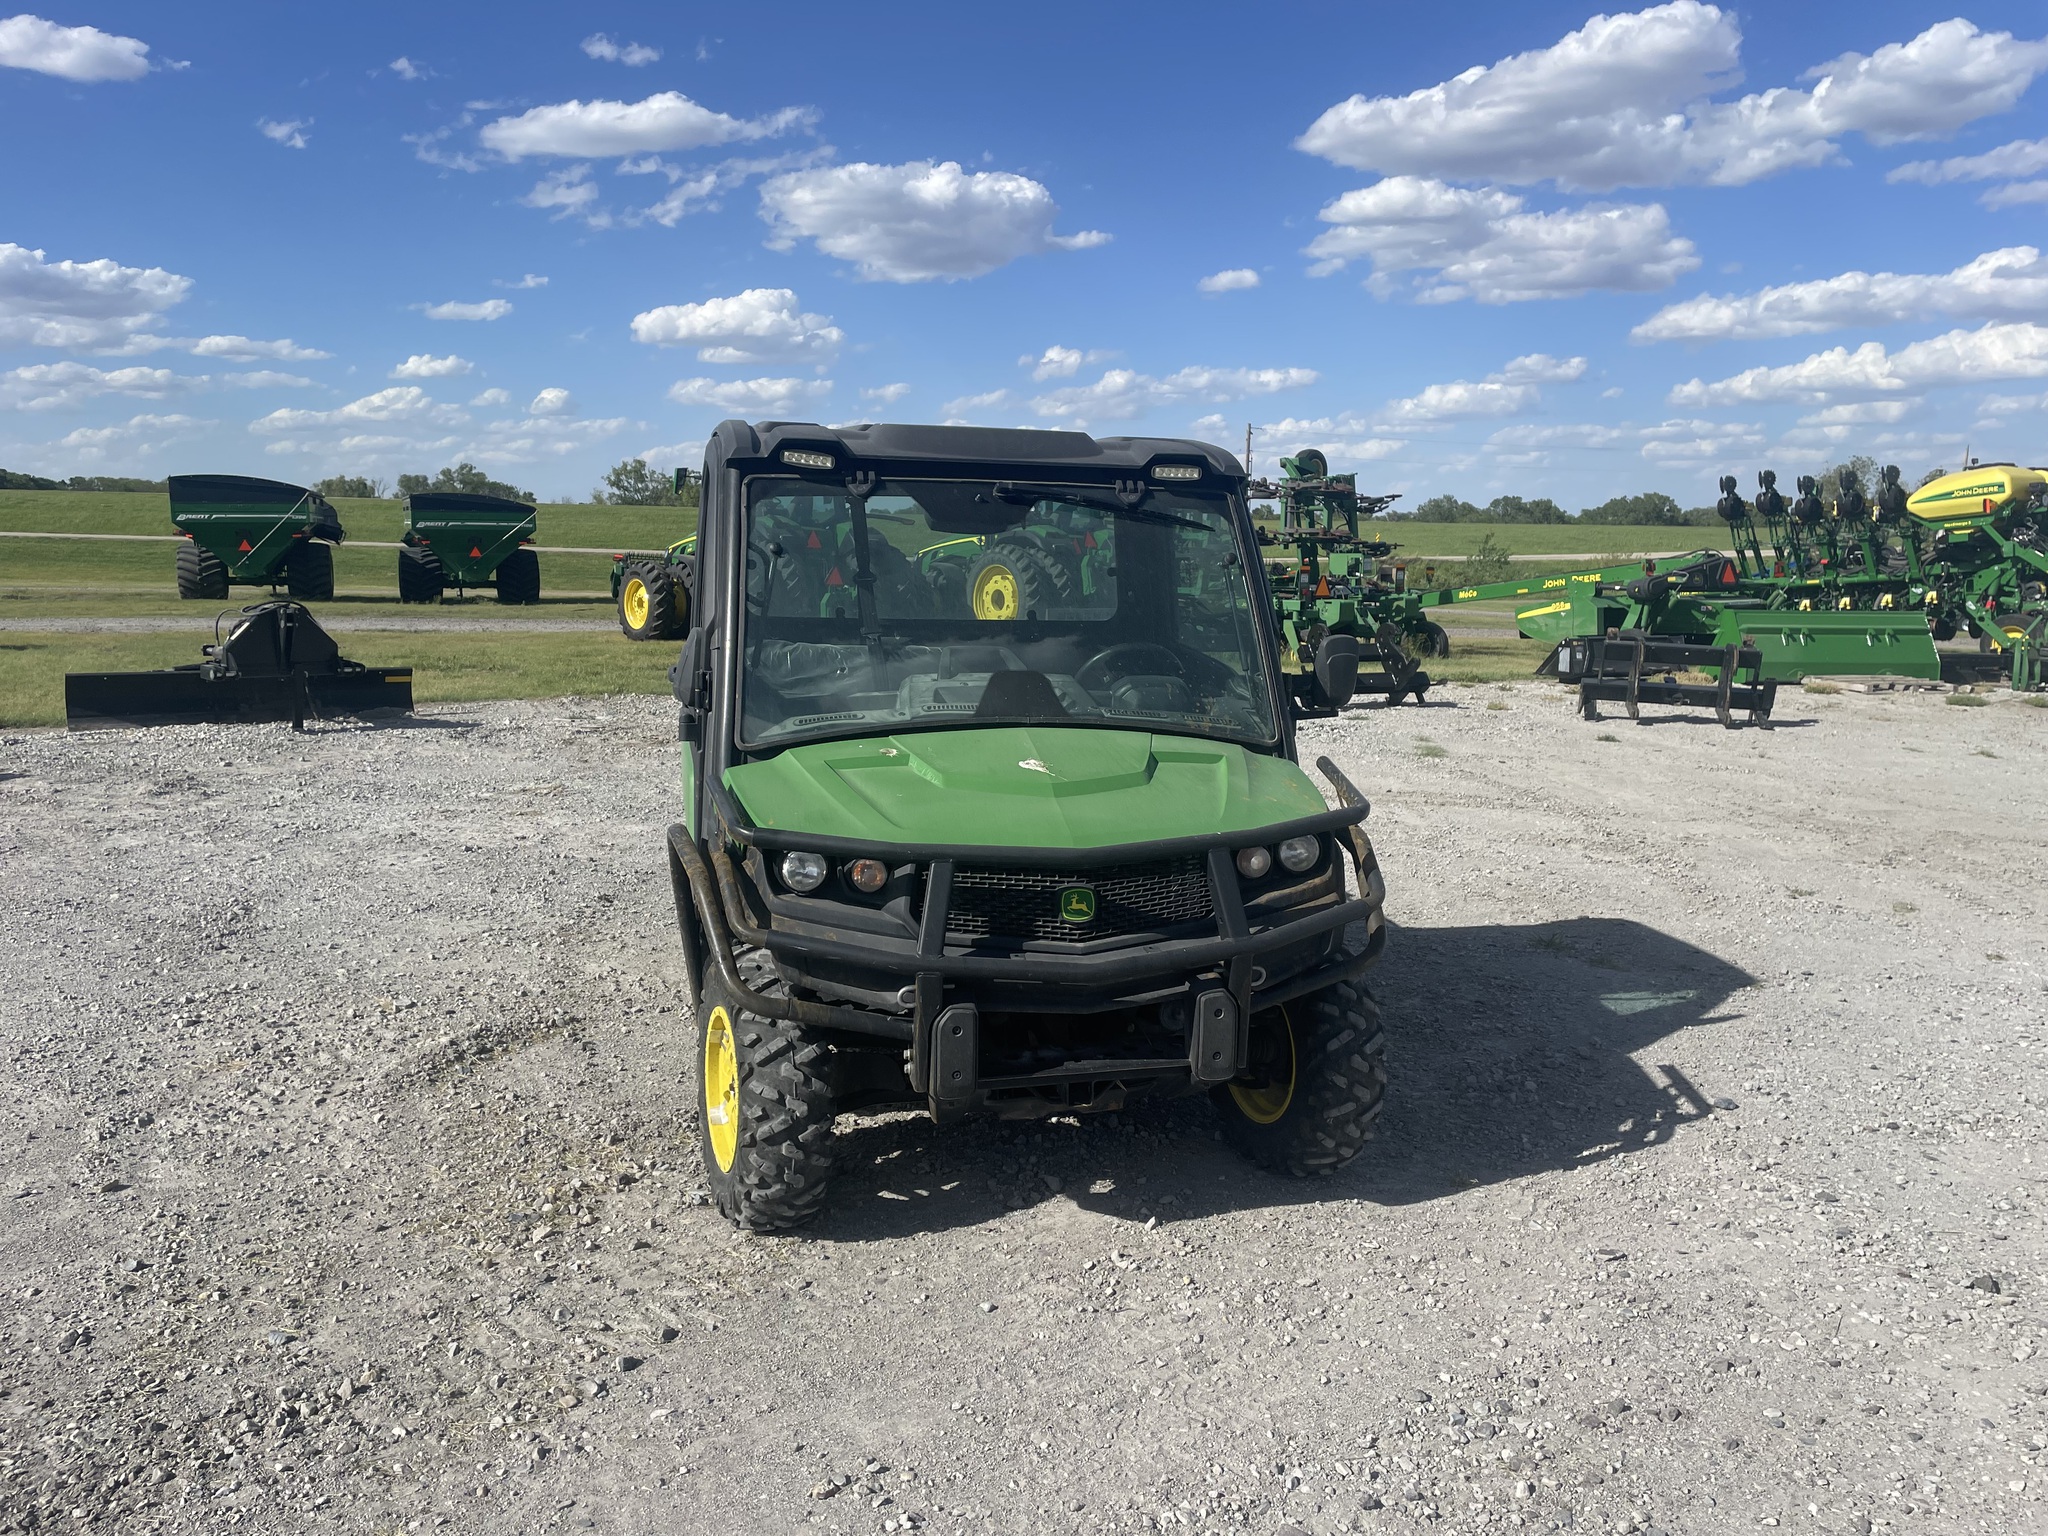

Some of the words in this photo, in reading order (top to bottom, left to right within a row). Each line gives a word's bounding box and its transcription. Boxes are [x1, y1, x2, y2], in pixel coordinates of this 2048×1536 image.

[1951, 489, 1972, 497] JOHN
[1973, 485, 1999, 494] DEERE
[1542, 578, 1566, 589] JOHN
